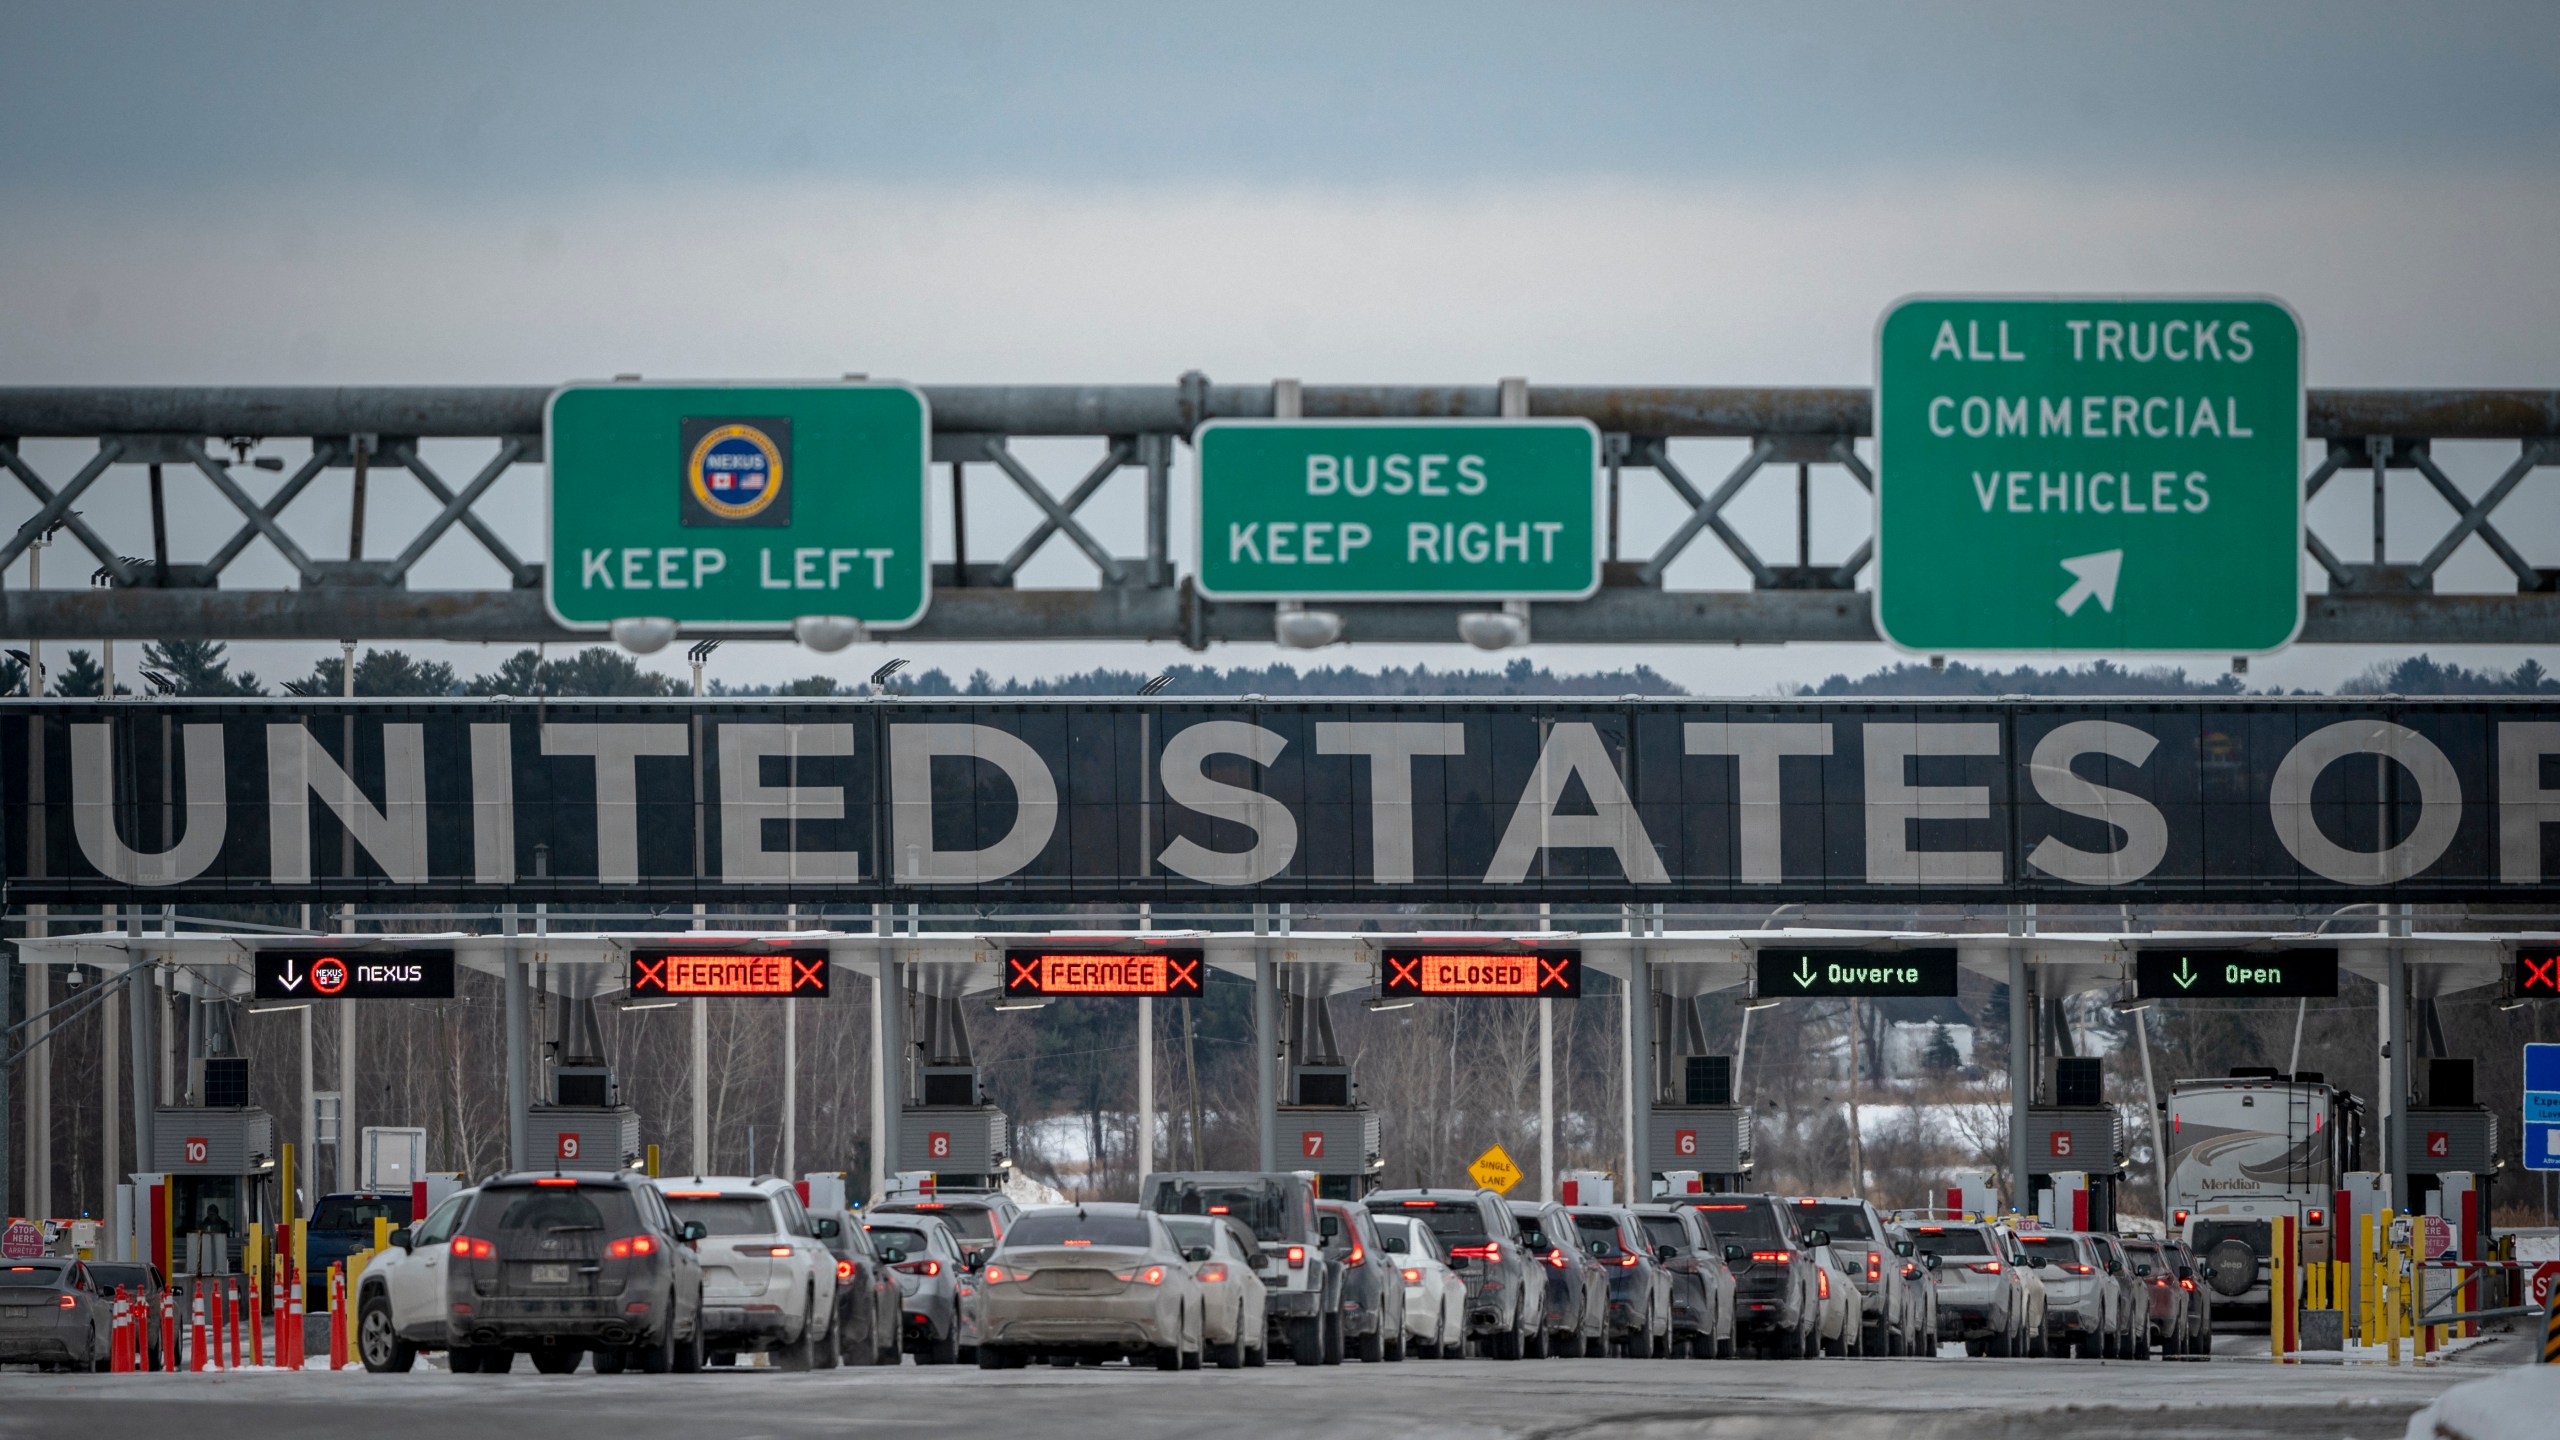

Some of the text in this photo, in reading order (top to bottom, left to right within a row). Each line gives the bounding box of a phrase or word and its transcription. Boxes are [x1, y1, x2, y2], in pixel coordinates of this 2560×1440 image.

[1933, 321, 2253, 361] ALL TRUCKS
[1930, 397, 2253, 437] COMMERCIAL
[706, 454, 766, 470] NEXUS
[1308, 455, 1488, 496] BUSES
[1974, 473, 2210, 513] VEHICLES
[1229, 522, 1563, 563] KEEP RIGHT
[582, 548, 893, 589] KEEP LEFT
[70, 722, 1058, 887] UNITED
[1157, 720, 2168, 887] STATES
[315, 968, 344, 977] NEXUS
[357, 965, 422, 982] NEXUS
[676, 957, 780, 986] FERMÉE
[1051, 956, 1154, 985] FERMÉE
[1439, 965, 1522, 984] CLOSED
[1828, 963, 1919, 984] Ouverte
[2225, 964, 2281, 985] Open
[187, 1143, 206, 1161] 10
[563, 1139, 577, 1157] 9
[934, 1137, 947, 1156] 8
[1309, 1137, 1322, 1155] 7
[1681, 1135, 1695, 1153] 6
[2058, 1137, 2070, 1155] 5
[2432, 1137, 2447, 1155] 4
[1480, 1160, 1511, 1172] SINGLE
[1481, 1175, 1506, 1186] LANE
[2201, 1178, 2260, 1190] Meridian
[13, 1226, 35, 1234] STOP
[2424, 1218, 2440, 1226] TOP
[2424, 1227, 2441, 1235] ERE
[12, 1234, 35, 1243] HERE
[2221, 1260, 2243, 1270] Jeep
